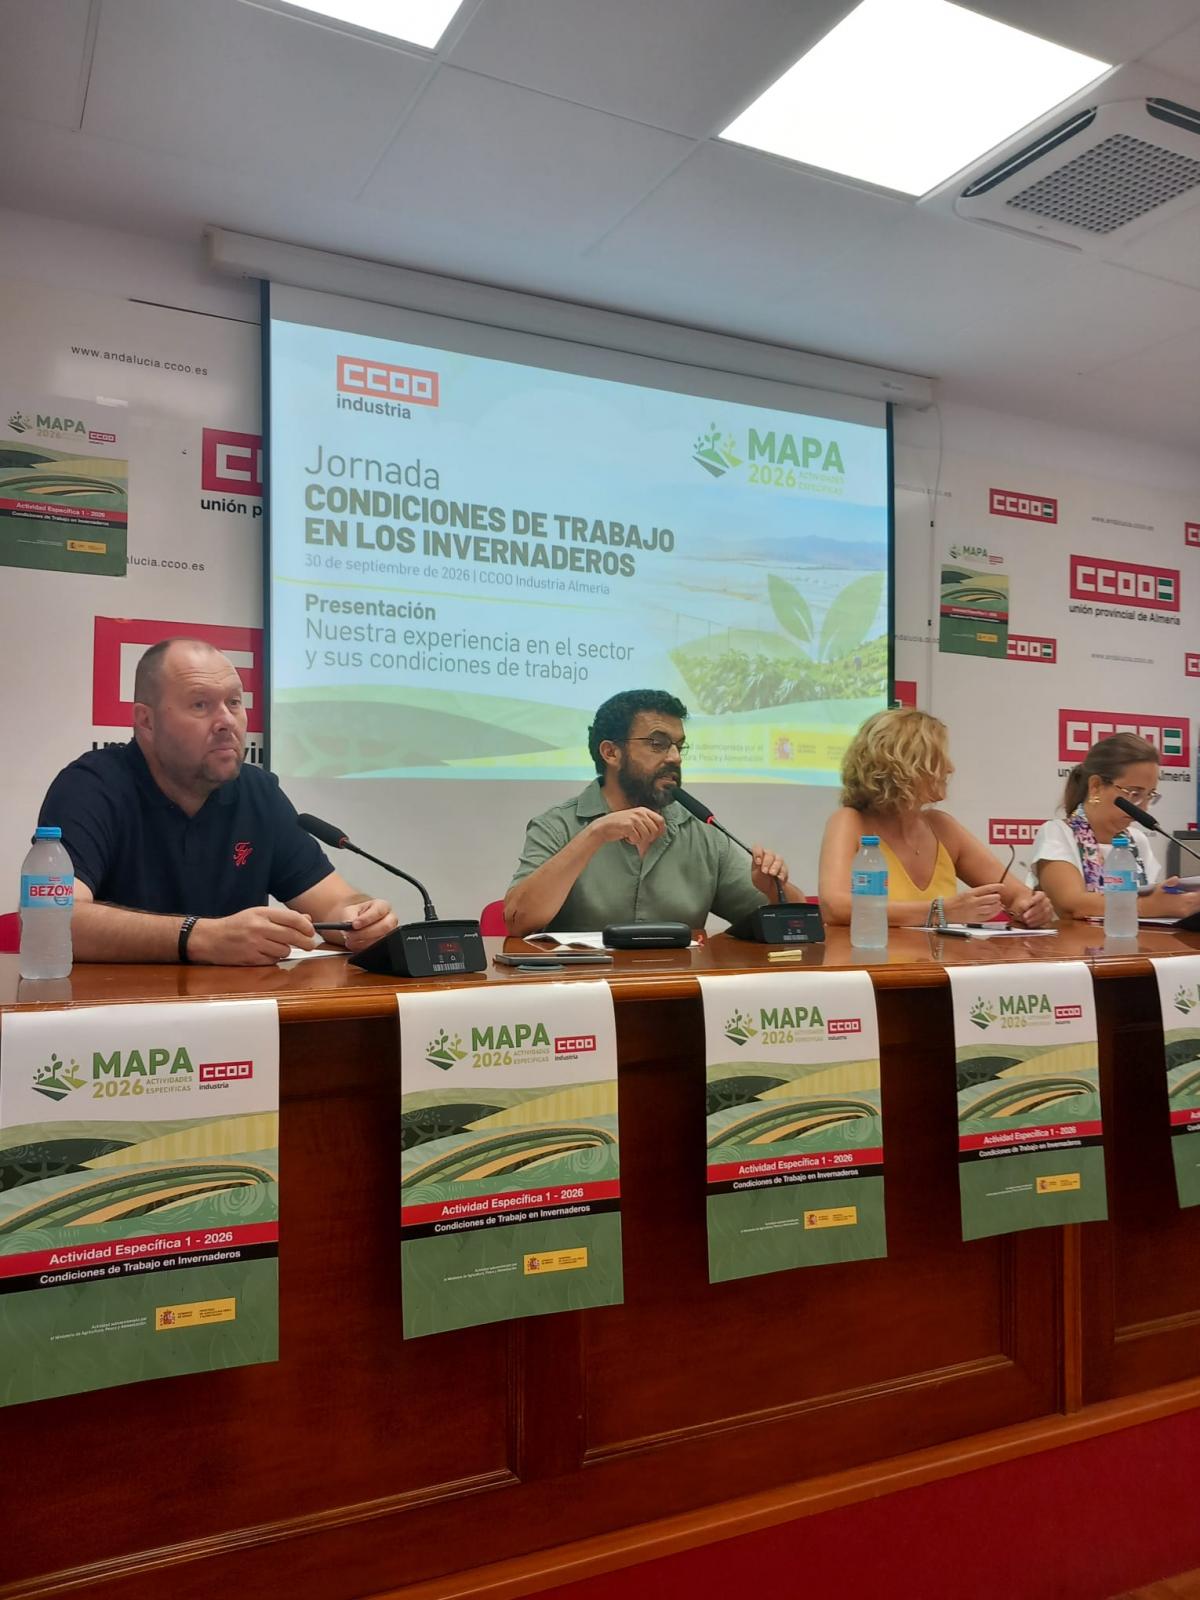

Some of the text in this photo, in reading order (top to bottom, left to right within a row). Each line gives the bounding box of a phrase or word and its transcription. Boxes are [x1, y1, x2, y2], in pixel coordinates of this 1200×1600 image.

[71, 345, 208, 376] www.andalucia.ccoo.es
[343, 362, 432, 399] CCOO
[336, 393, 412, 420] industria
[36, 414, 86, 434] MAPA
[90, 432, 115, 441] CCOO
[748, 428, 845, 474] MAPA
[304, 444, 441, 491] Jornada
[748, 464, 796, 488] 2026
[200, 496, 247, 515] unión
[993, 494, 1042, 516] CCOO
[304, 483, 675, 553] CONDICIONES DE TRABAJO
[304, 517, 636, 578] EN LOS INVERNADEROS
[963, 545, 988, 557] MAPA
[127, 555, 205, 571] lucia.ccoo.es
[304, 553, 321, 567] 30
[325, 556, 342, 569] de
[345, 559, 420, 575] septiembre
[424, 565, 439, 578] de
[441, 566, 470, 581] 2026
[479, 570, 513, 586] CCOO
[516, 575, 566, 591] Industria
[1075, 564, 1156, 599] CCOO
[305, 593, 436, 621] Presentación
[1068, 604, 1093, 616] unión
[1095, 607, 1136, 620] provincial
[1137, 611, 1148, 622] de
[305, 617, 635, 662] Nuestra experiencia en el sector
[305, 650, 589, 685] y sus condiciones de trabajo
[999, 993, 1052, 1016] MAPA
[1056, 1007, 1081, 1017] CCOO
[760, 1006, 824, 1030] MAPA
[829, 1020, 860, 1032] CCOO
[1000, 1015, 1027, 1029] 2026
[471, 1022, 551, 1052] MAPA
[557, 1039, 594, 1051] CCOO
[761, 1030, 794, 1045] 2026
[92, 1046, 194, 1080] MAPA
[471, 1051, 513, 1068] 2026
[146, 1075, 193, 1085] ACTIVIDADES
[203, 1065, 250, 1079] CCOO
[92, 1078, 144, 1099] 2026
[199, 1081, 229, 1091] industria
[984, 1132, 1014, 1144] Actividad
[738, 1162, 776, 1175] Actividad
[778, 1157, 820, 1170] Específica
[821, 1156, 826, 1164] 1
[833, 1153, 853, 1163] 2026
[733, 1179, 773, 1190] Condiciones
[784, 1174, 807, 1184] Trabajo
[441, 1200, 489, 1216] Actividad
[491, 1193, 543, 1209] Específica
[545, 1192, 550, 1201] 1
[560, 1188, 584, 1200] 2026
[434, 1204, 591, 1233] Condiciones de Trabajo en Invernaderos
[49, 1247, 112, 1266] Actividad
[115, 1238, 182, 1257] Específica
[185, 1236, 191, 1247] 1
[204, 1231, 233, 1245] 2026
[40, 1250, 241, 1285] Condiciones de Trabajo en Invernaderos
